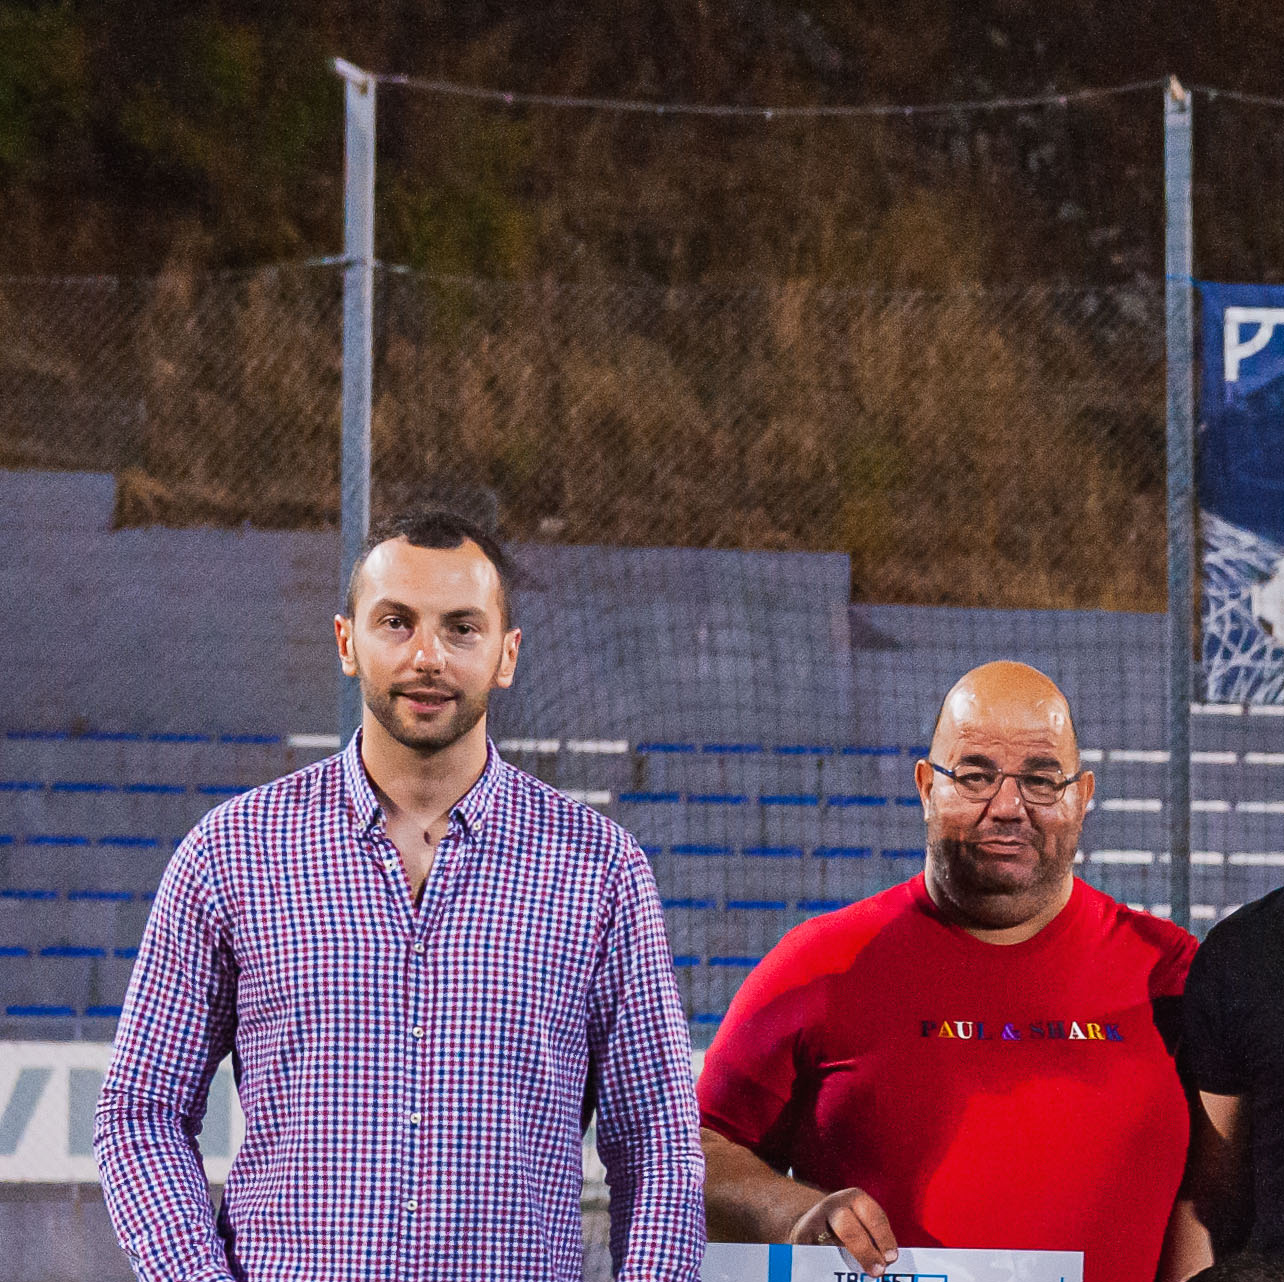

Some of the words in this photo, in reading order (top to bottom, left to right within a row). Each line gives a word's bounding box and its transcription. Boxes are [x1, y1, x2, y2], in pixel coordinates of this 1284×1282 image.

[920, 1020, 993, 1040] PAUL
[1001, 1022, 1021, 1041] &
[1029, 1020, 1124, 1043] SHARK
